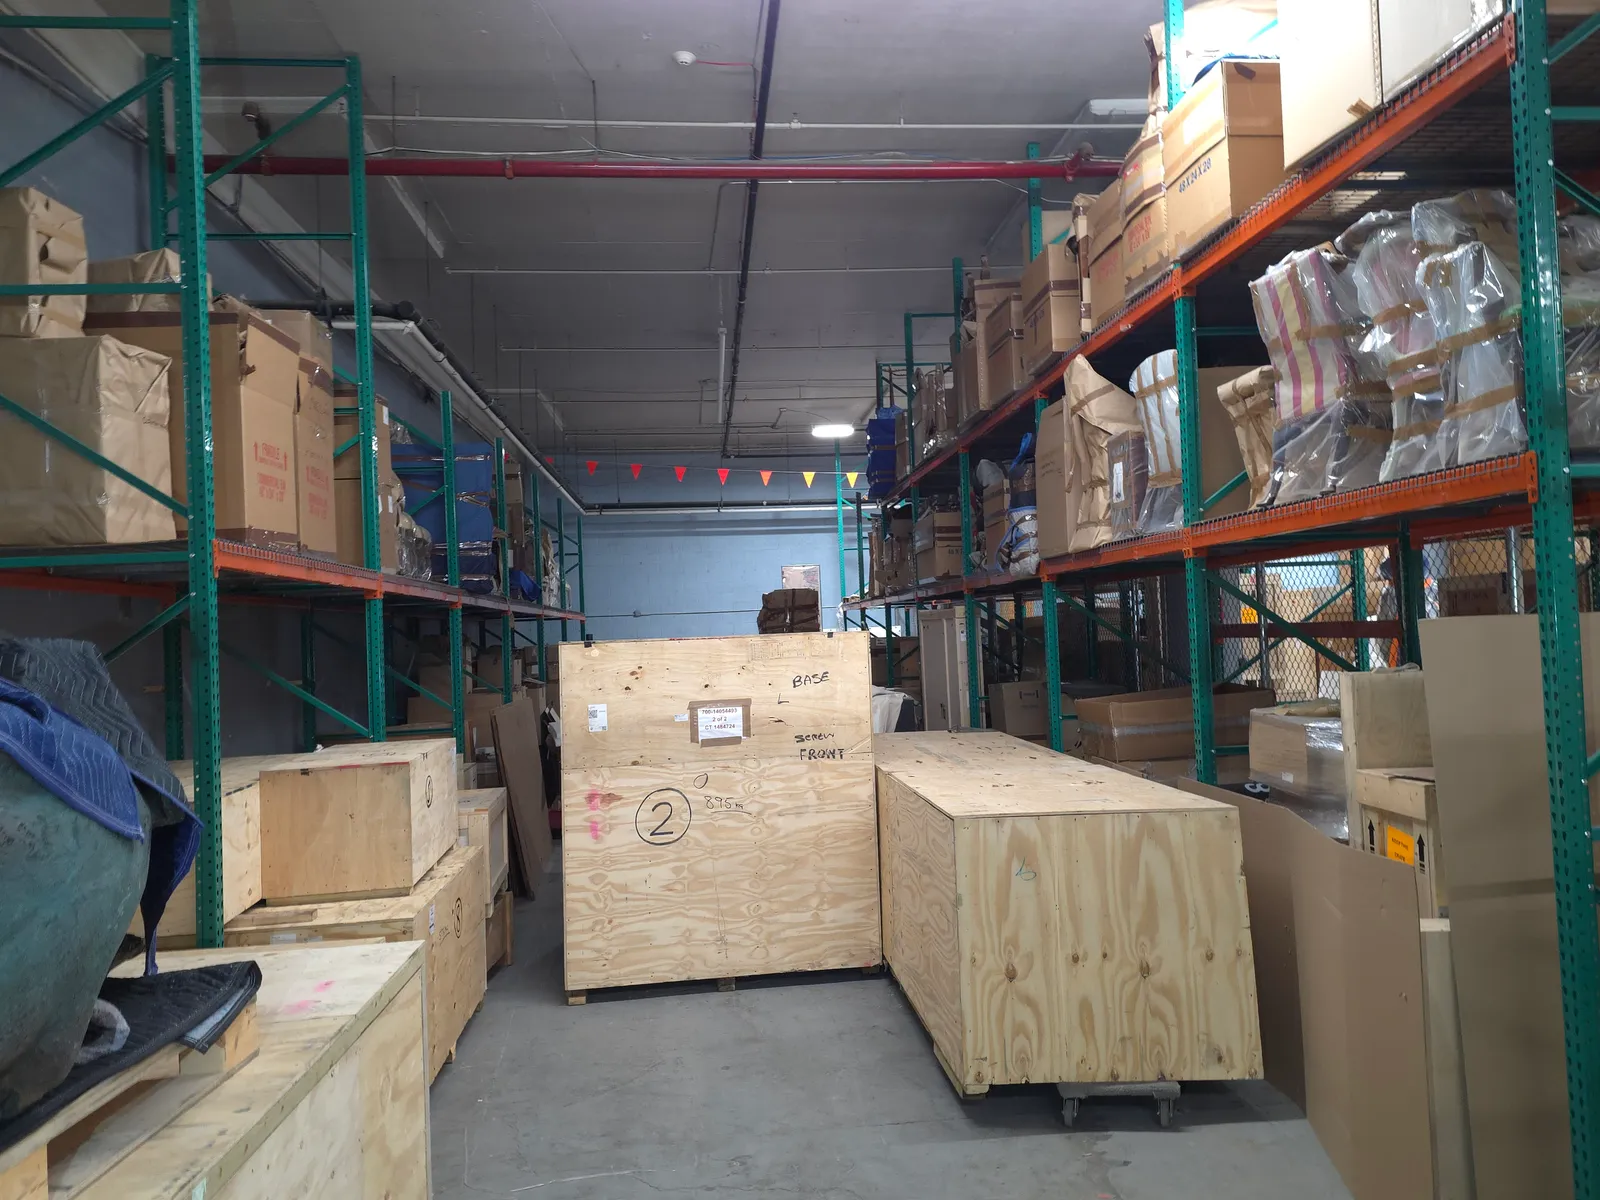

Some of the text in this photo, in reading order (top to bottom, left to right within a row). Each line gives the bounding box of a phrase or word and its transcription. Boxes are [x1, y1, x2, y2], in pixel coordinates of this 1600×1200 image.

[792, 671, 830, 688] BASE
[799, 748, 845, 761] FRONT
[649, 801, 674, 837] 2
